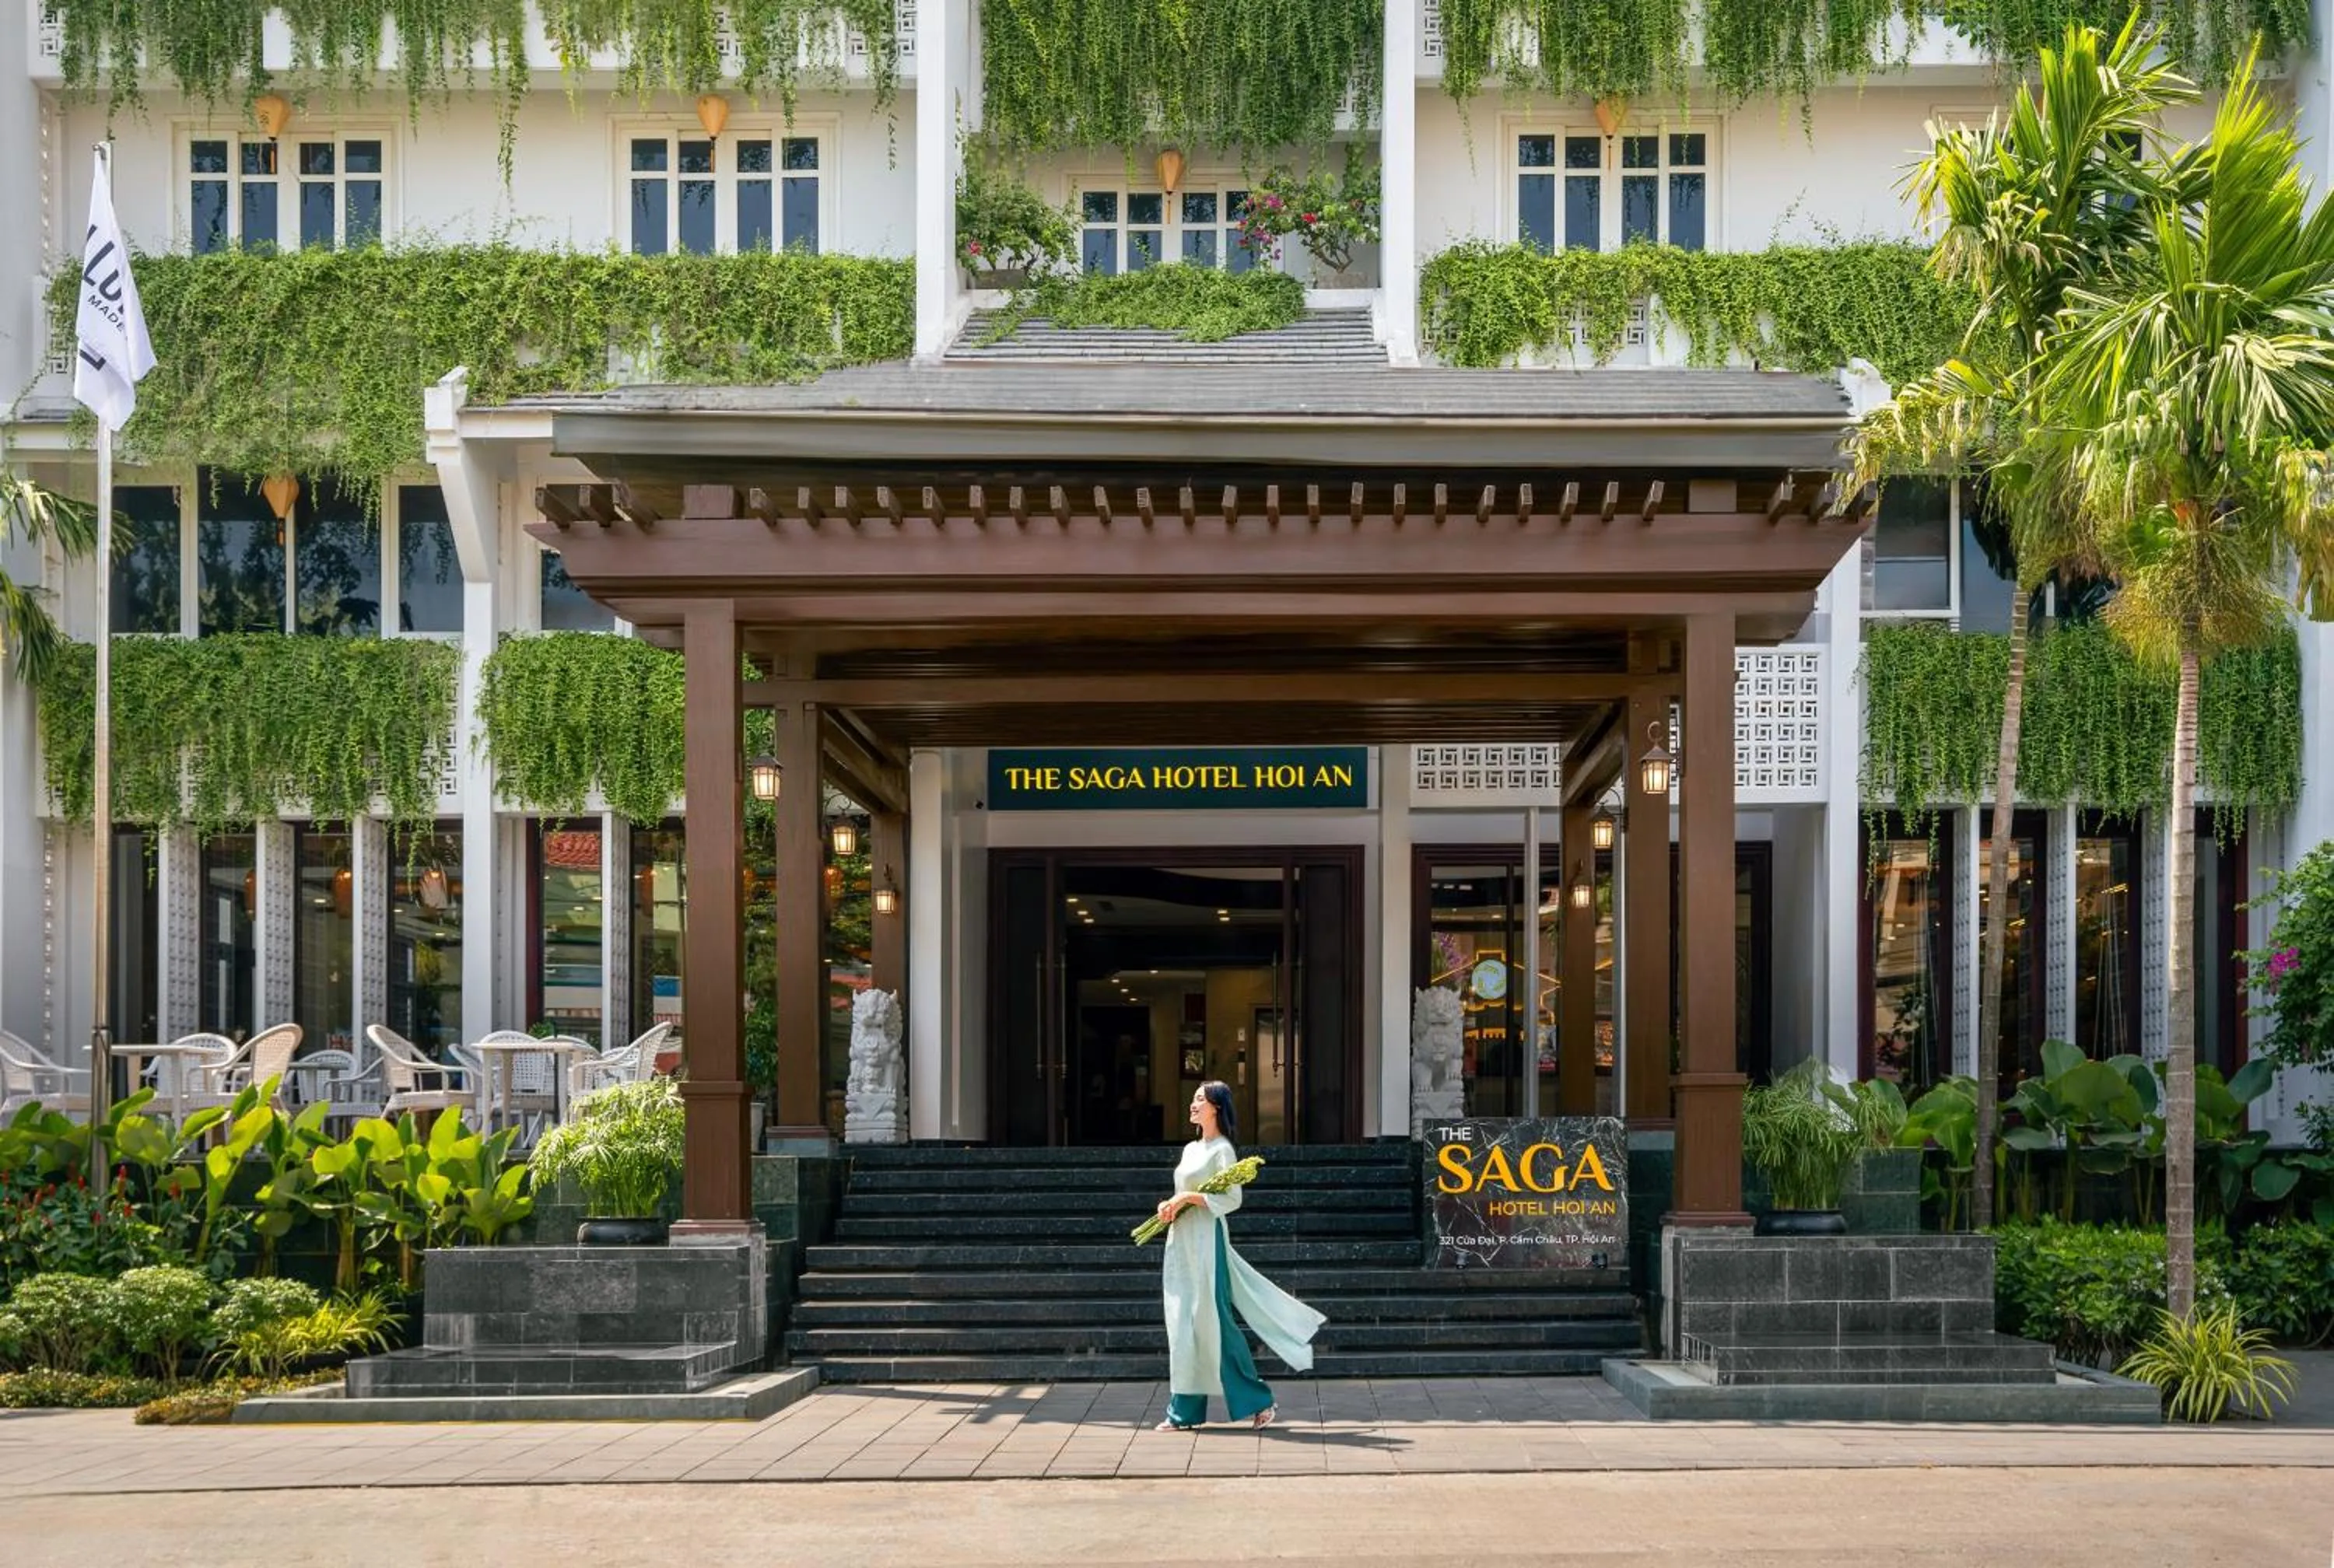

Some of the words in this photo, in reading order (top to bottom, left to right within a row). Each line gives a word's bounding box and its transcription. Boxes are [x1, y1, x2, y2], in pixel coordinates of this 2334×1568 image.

[1004, 767, 1060, 789] THE
[1068, 766, 1145, 789] SAGA
[1153, 766, 1246, 789] HOTEL
[1254, 765, 1304, 788] HOI
[1312, 765, 1352, 787] AN
[1439, 1127, 1471, 1141] THE
[1438, 1143, 1614, 1193] SAGA
[1489, 1202, 1547, 1216] HOTEL
[1553, 1201, 1585, 1215] HOI
[1589, 1201, 1616, 1215] AN
[1565, 1235, 1580, 1244] TP.
[1601, 1235, 1616, 1244] An
